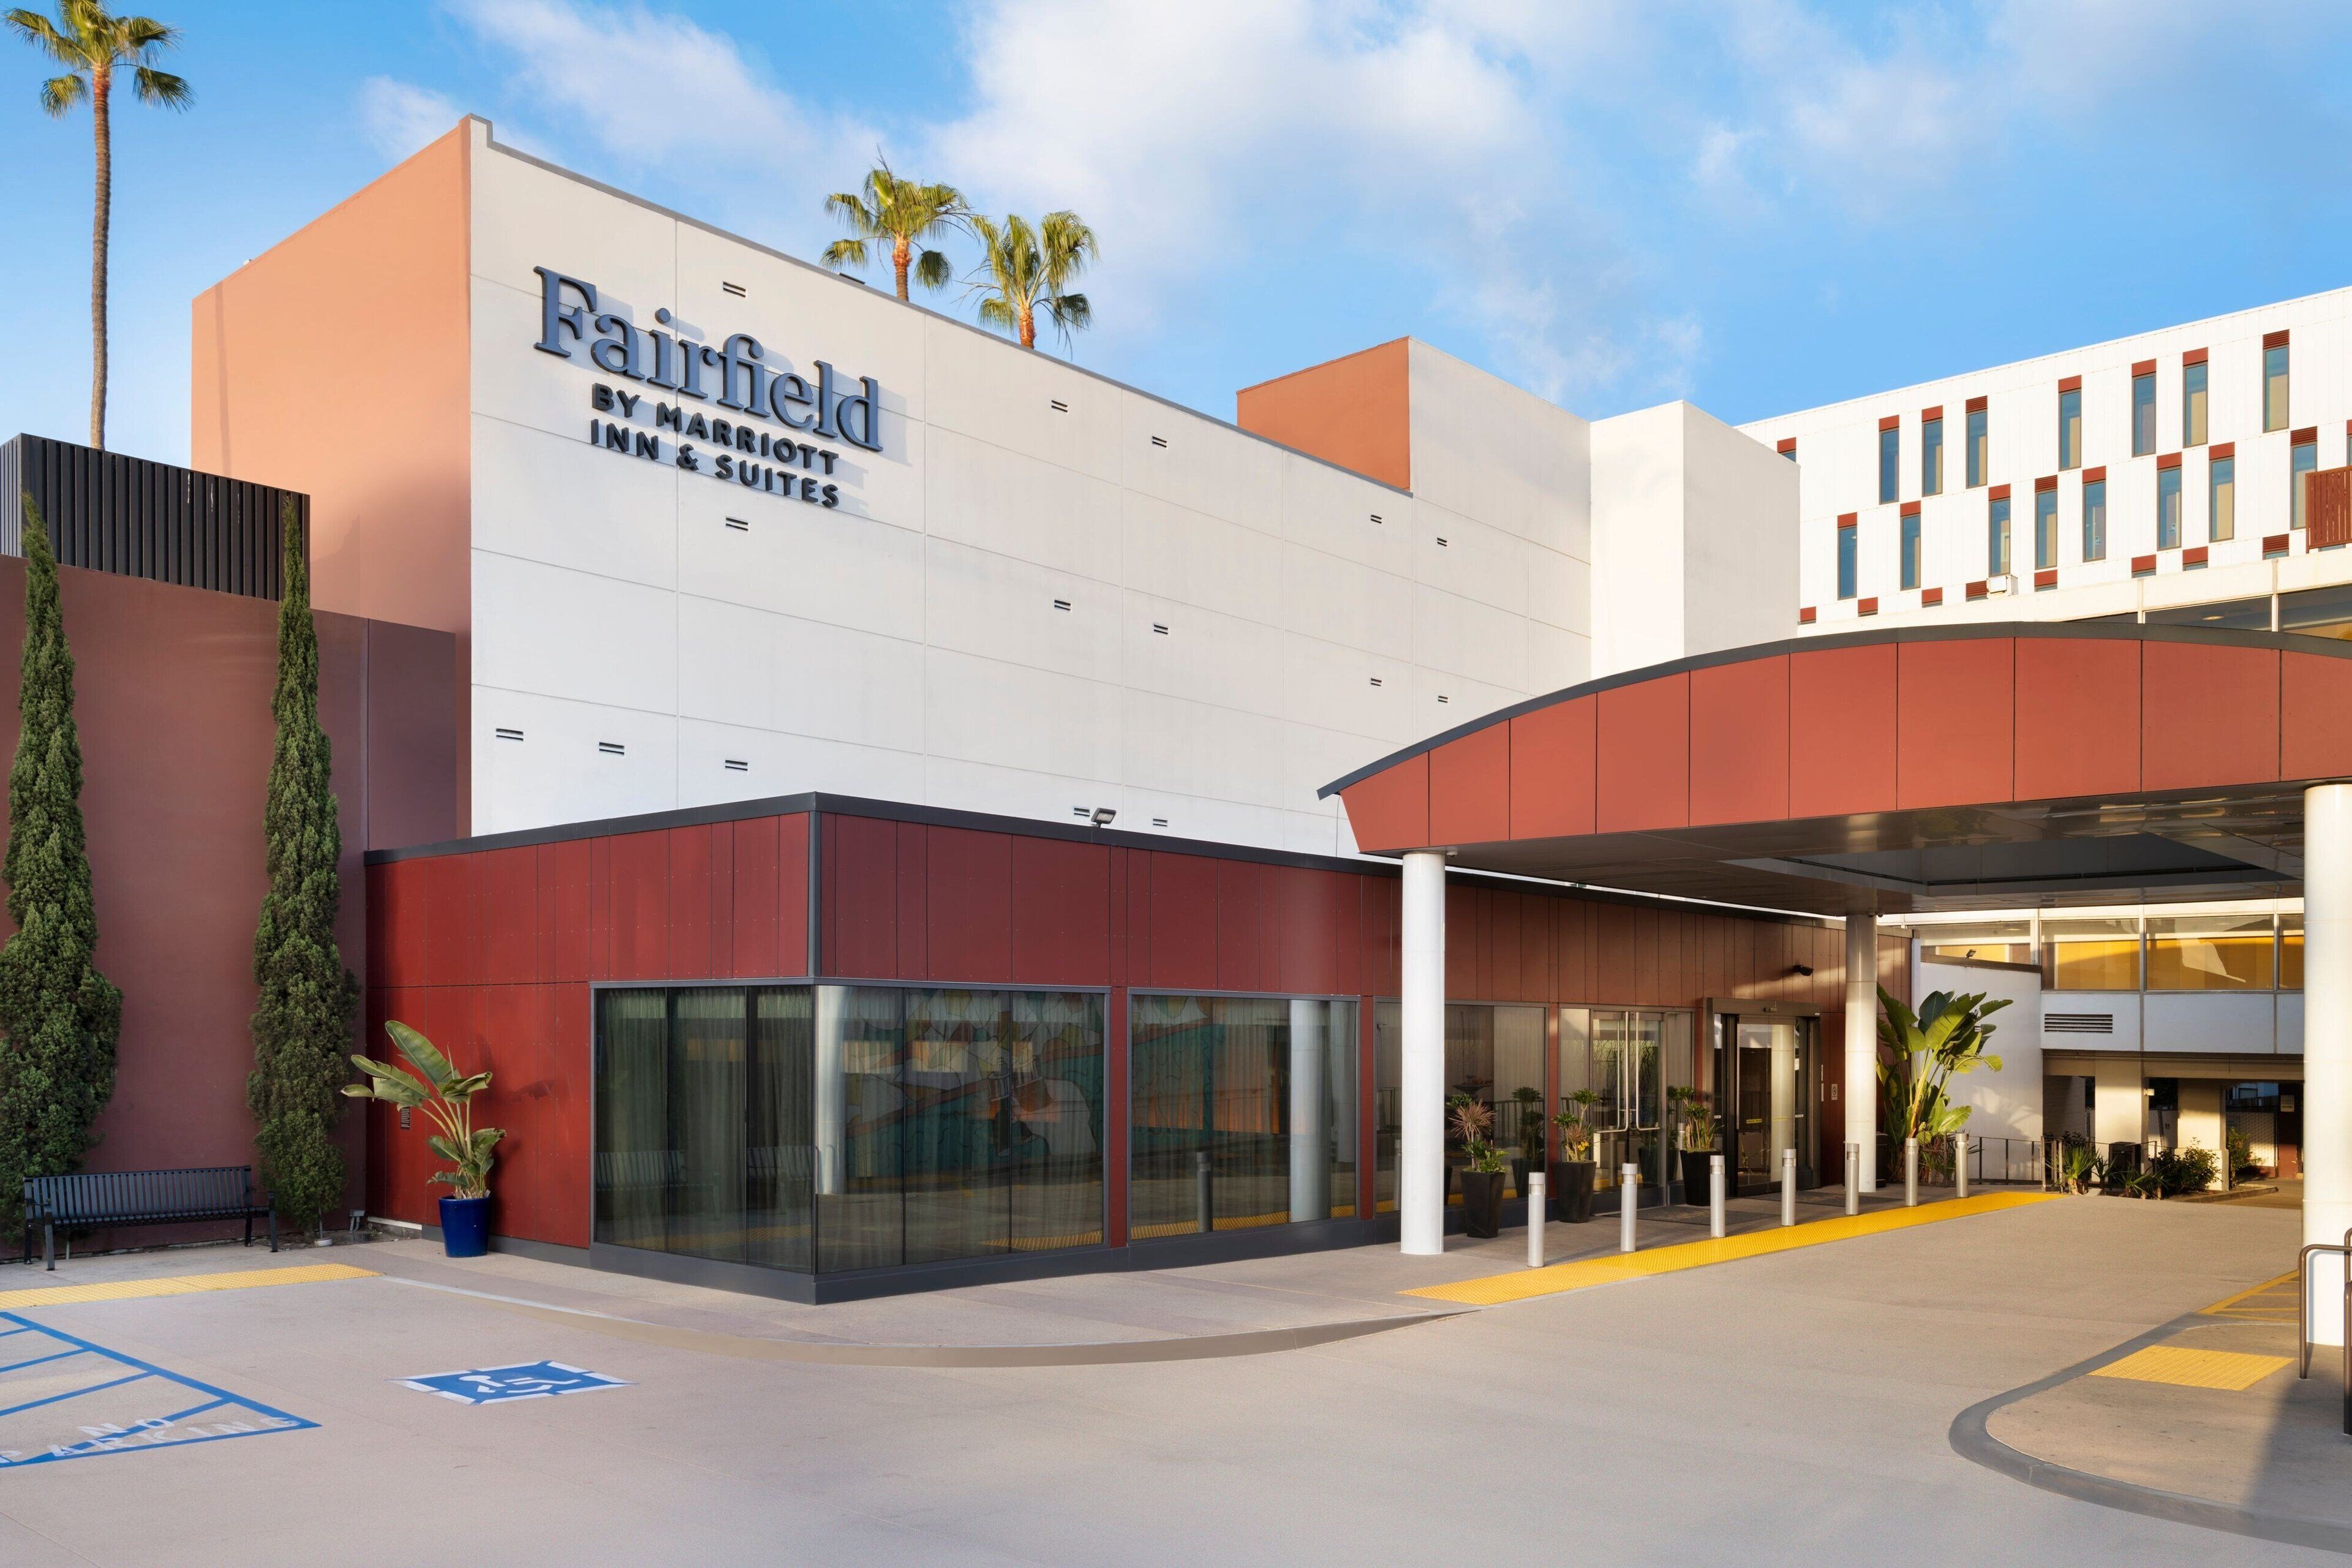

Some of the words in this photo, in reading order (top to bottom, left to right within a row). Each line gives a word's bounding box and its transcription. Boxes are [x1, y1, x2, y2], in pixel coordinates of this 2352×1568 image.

[533, 266, 883, 452] Fairfield
[590, 418, 659, 460] INN
[677, 443, 698, 471] &
[715, 454, 839, 508] SUITES
[592, 382, 641, 418] BY
[656, 402, 839, 475] MARRIOTT
[76, 1418, 173, 1437] NO
